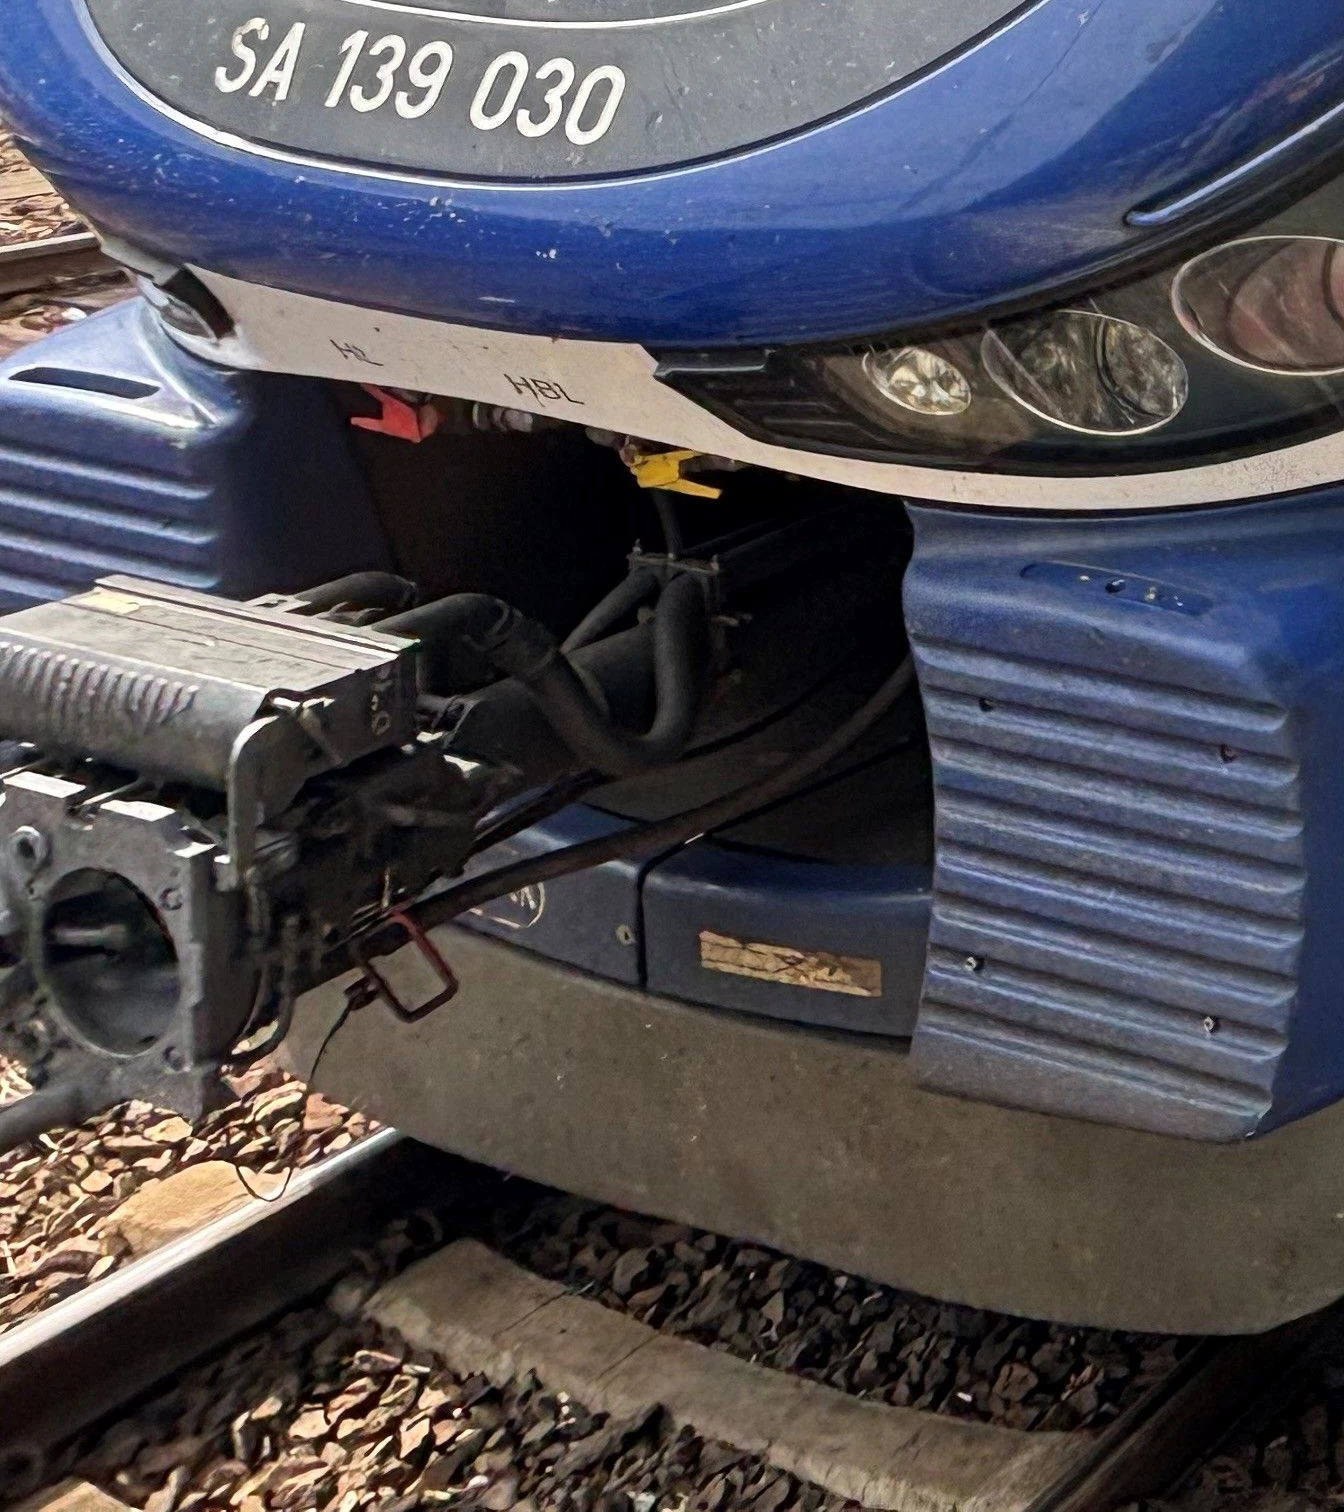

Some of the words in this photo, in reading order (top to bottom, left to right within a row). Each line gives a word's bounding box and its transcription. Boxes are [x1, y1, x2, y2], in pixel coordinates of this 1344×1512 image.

[215, 17, 306, 101] SA
[324, 29, 453, 119] 139
[469, 51, 626, 146] 030
[503, 373, 585, 408] HBL
